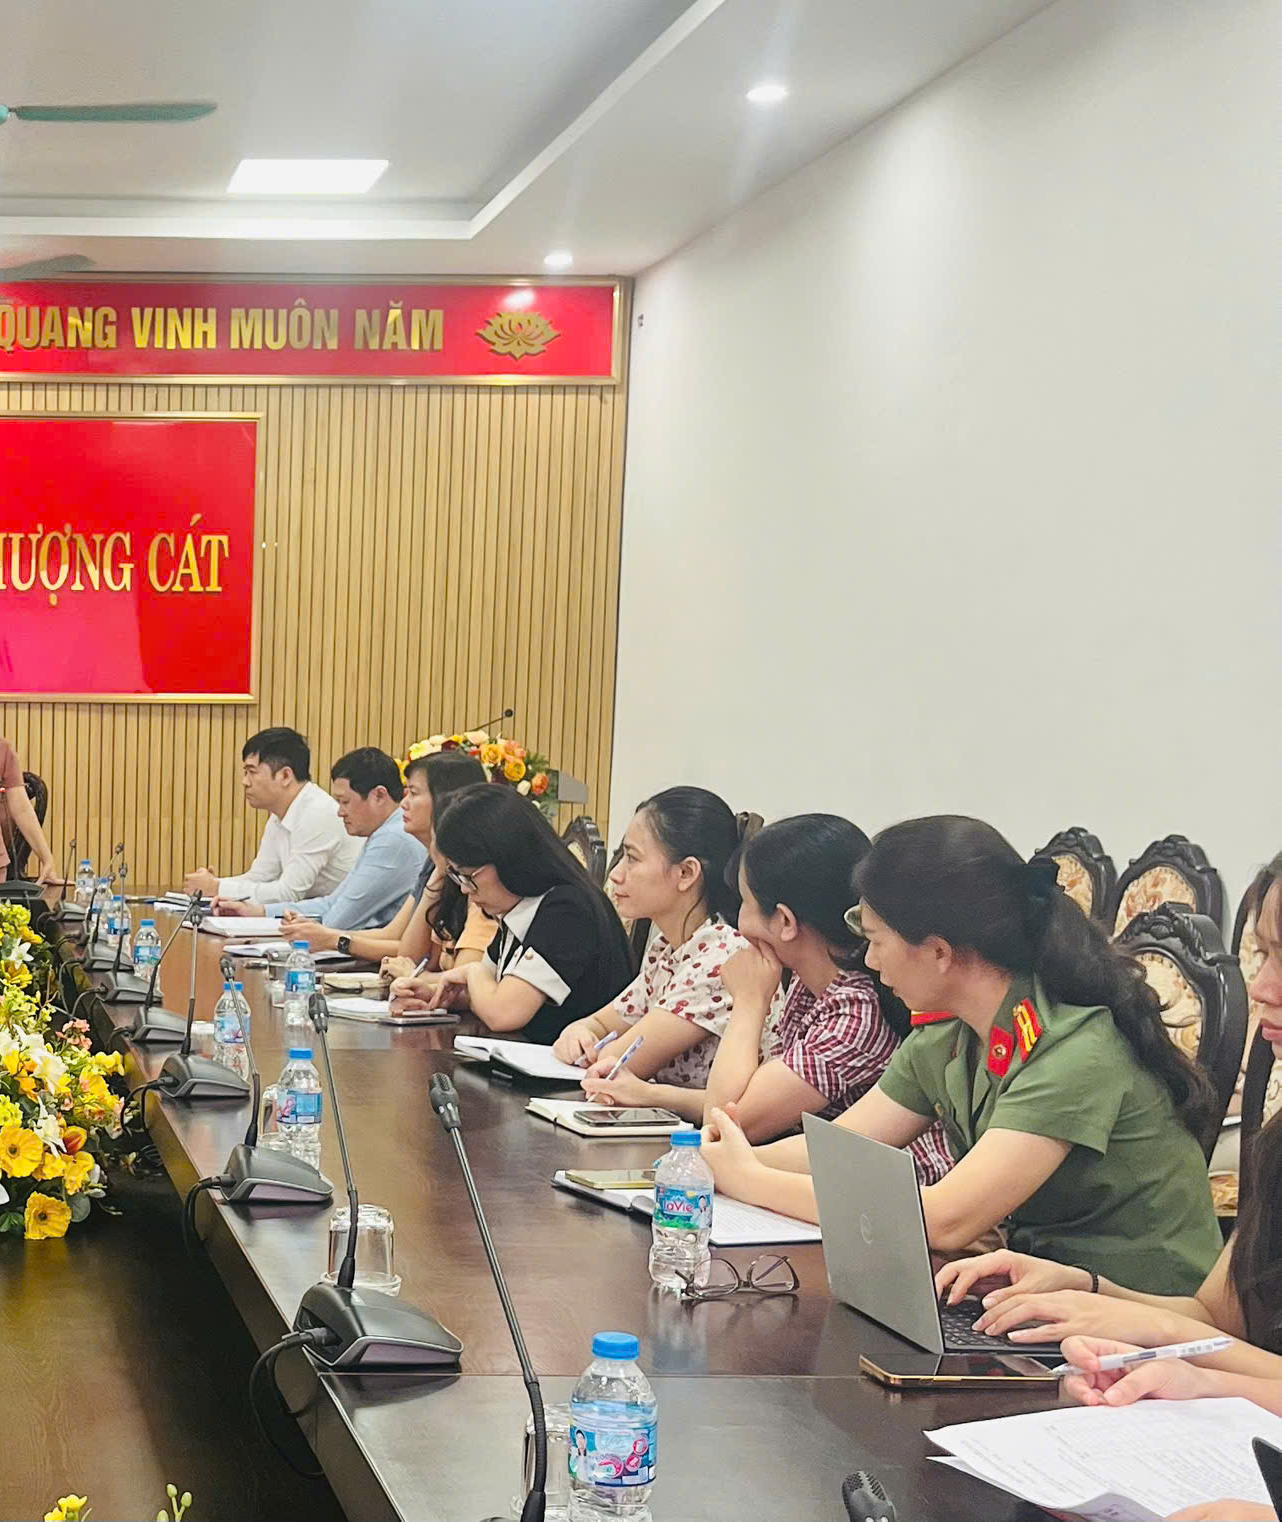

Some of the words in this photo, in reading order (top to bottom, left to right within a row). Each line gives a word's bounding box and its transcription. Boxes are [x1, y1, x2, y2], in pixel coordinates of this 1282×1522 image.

[131, 306, 217, 350] VINH
[230, 298, 339, 351] MUÔN
[354, 300, 444, 351] NĂM
[148, 513, 229, 593] CÁT
